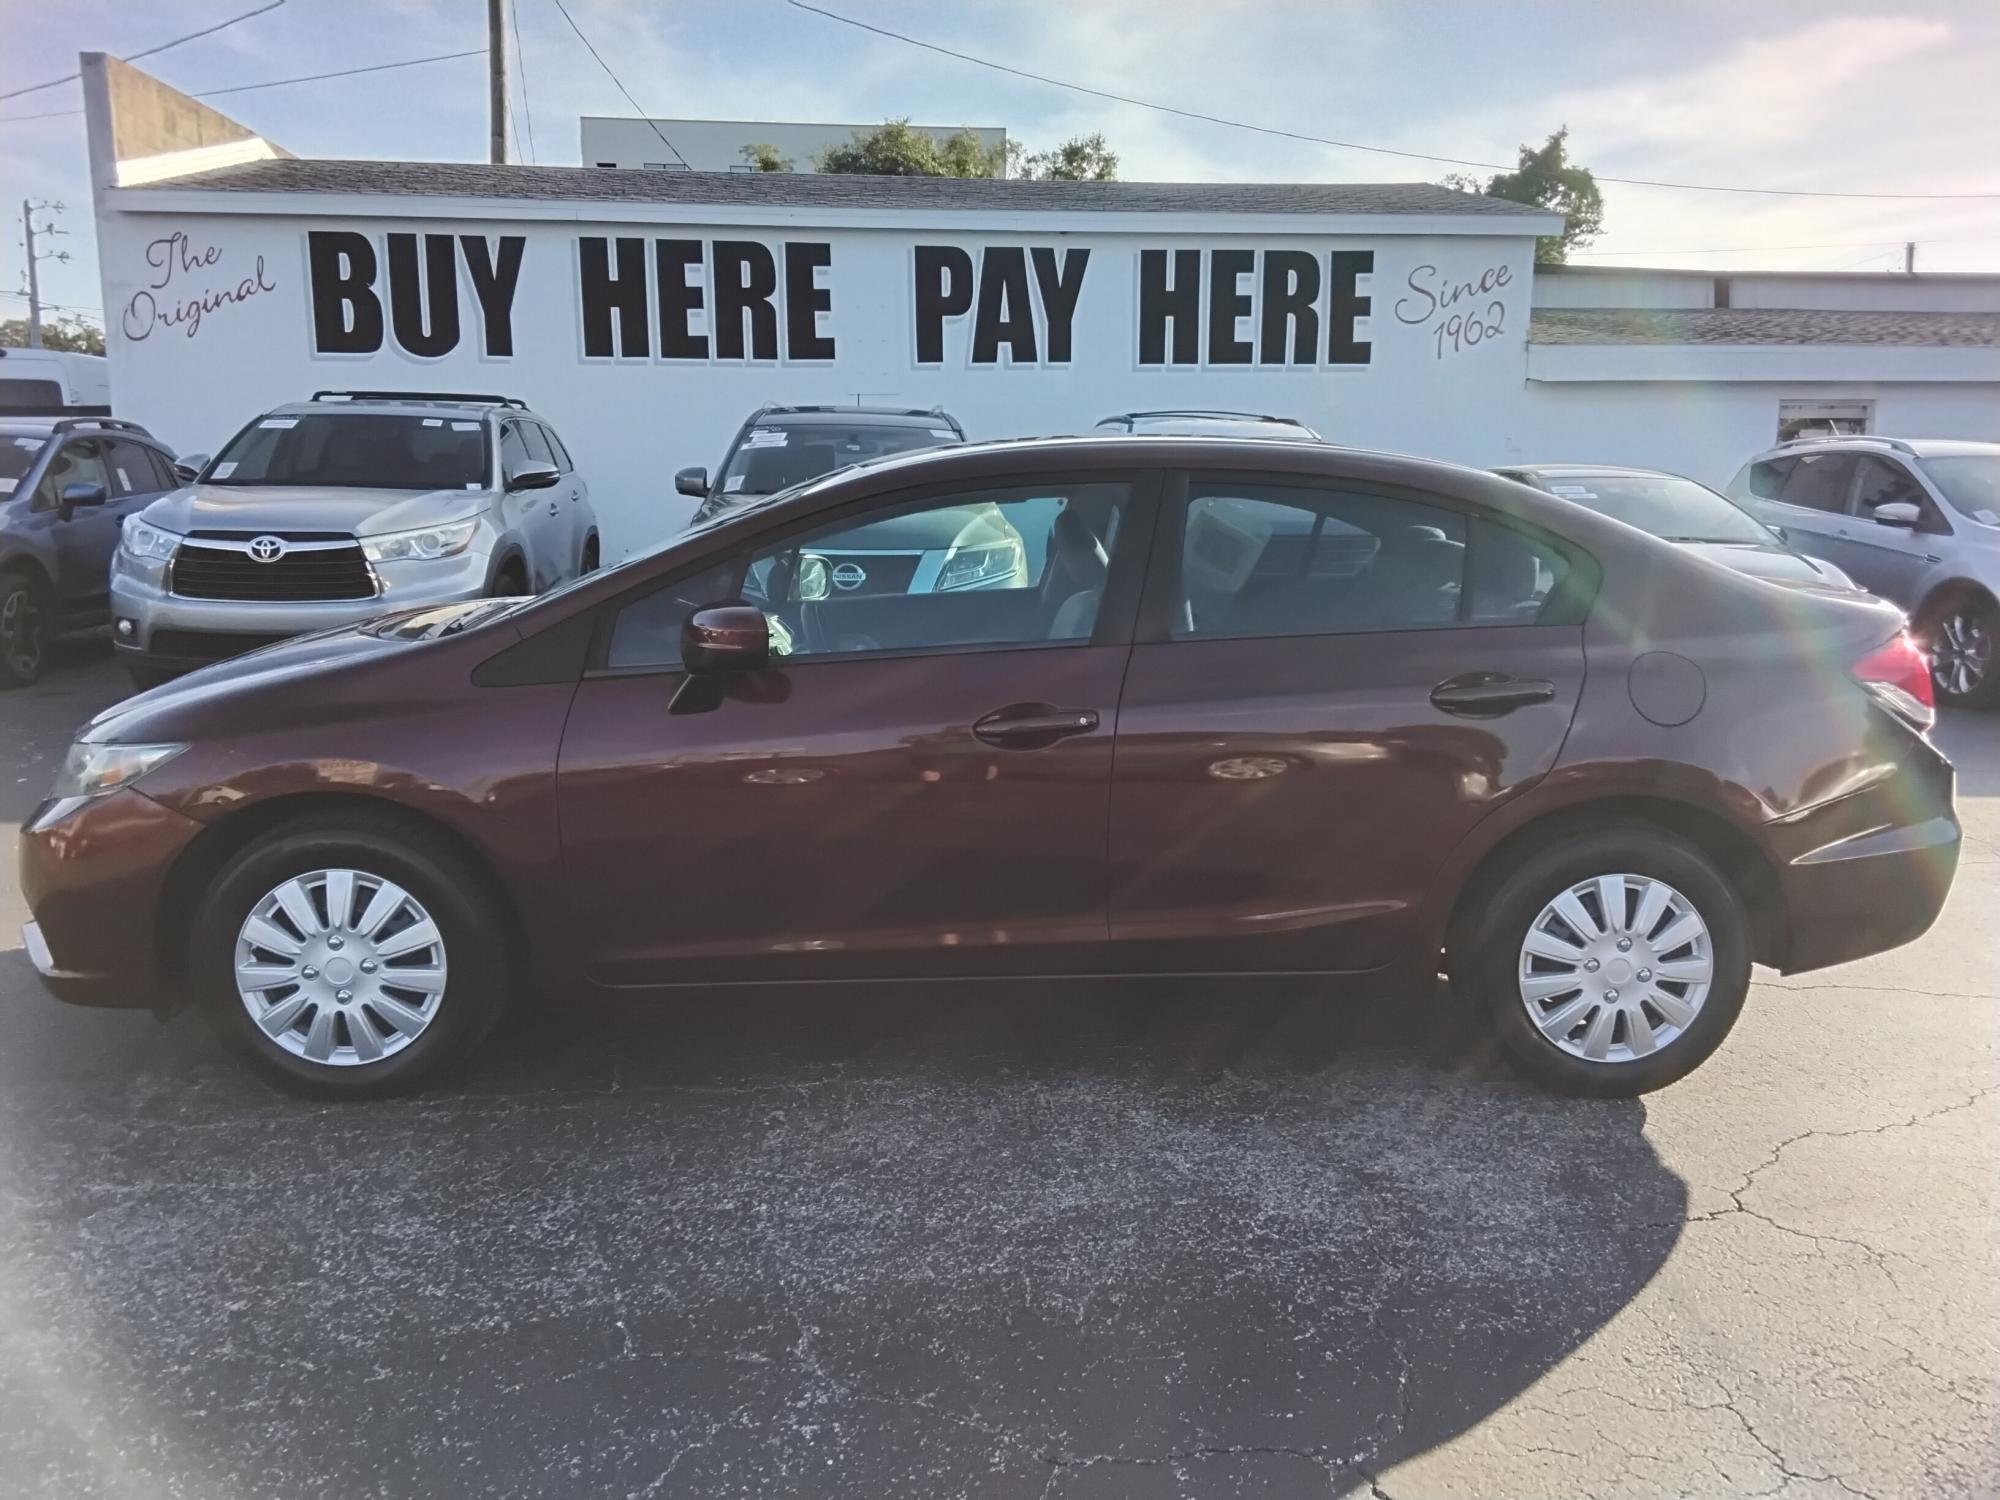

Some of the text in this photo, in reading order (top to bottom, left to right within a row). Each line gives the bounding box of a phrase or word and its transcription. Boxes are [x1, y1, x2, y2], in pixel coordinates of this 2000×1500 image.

[146, 230, 223, 290] The
[122, 254, 277, 342] Original
[308, 231, 1375, 365] BUY HERE PAY HERE
[1394, 263, 1513, 325] Since
[1432, 300, 1506, 361] 1962
